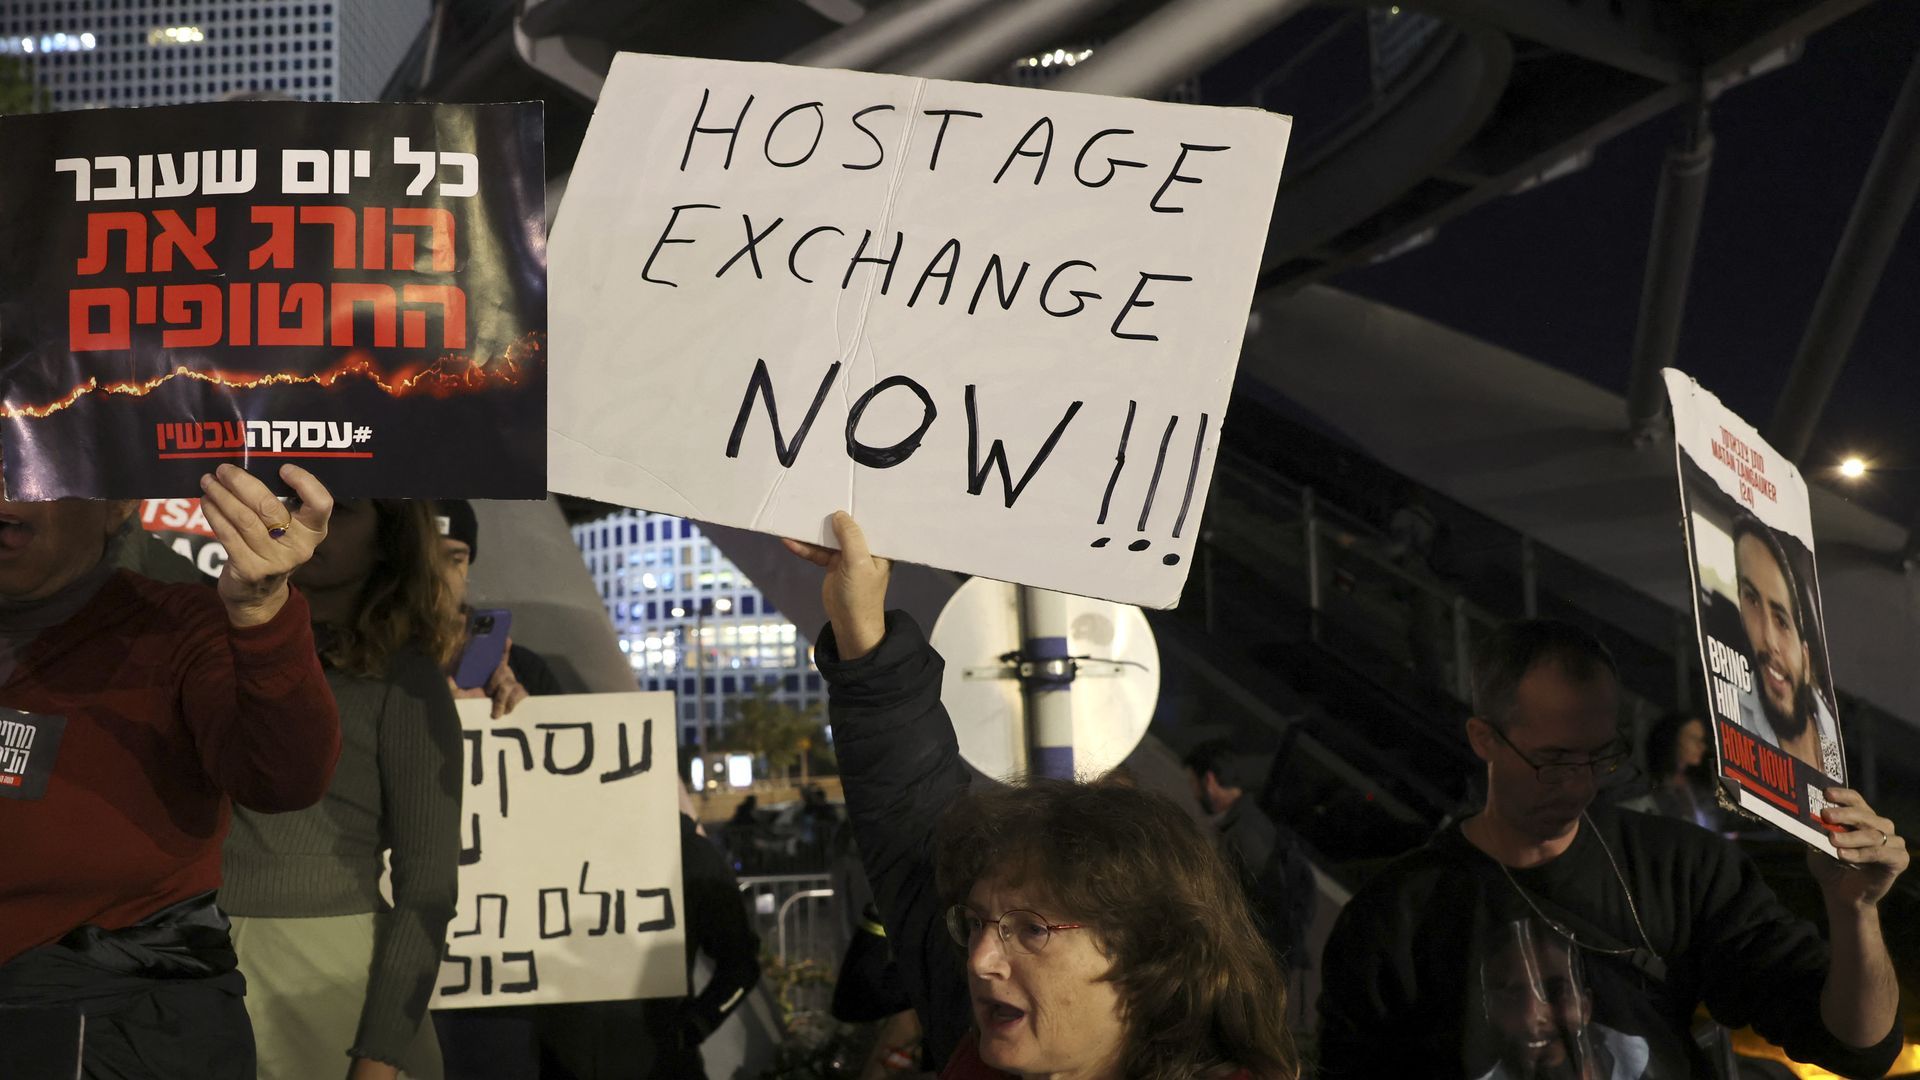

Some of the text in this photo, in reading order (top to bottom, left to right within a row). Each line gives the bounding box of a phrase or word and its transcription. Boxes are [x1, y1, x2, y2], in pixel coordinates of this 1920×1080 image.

[55, 136, 480, 202] כל יום שעובר
[680, 88, 1231, 214] HOSTAGE
[77, 205, 457, 276] הורג את
[641, 203, 1193, 342] EXCHANGE
[68, 281, 467, 353] החטופים
[1711, 437, 1736, 472] MATAN
[1739, 479, 1755, 509] (24)
[1707, 634, 1752, 693] BRING
[0, 720, 37, 750] מחזי
[1713, 675, 1742, 727] HIM
[1720, 720, 1797, 800] HOME NOW!
[539, 860, 676, 940] כולם
